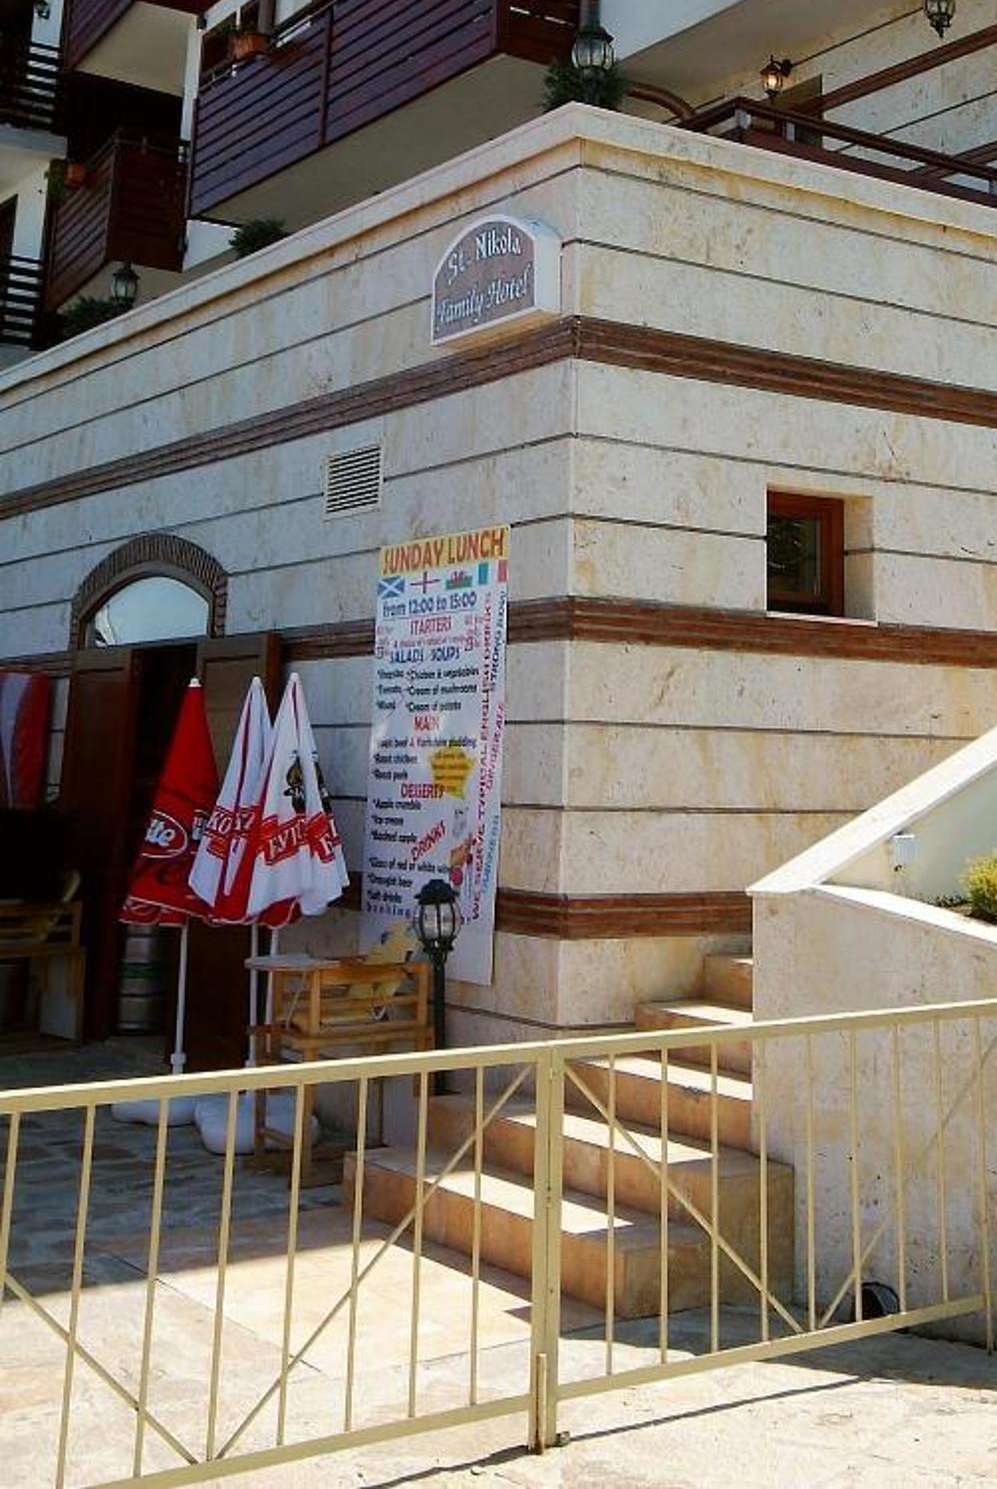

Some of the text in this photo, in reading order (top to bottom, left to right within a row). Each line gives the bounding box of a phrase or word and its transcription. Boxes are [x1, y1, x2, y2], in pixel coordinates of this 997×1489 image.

[475, 227, 522, 261] Nikola
[437, 261, 532, 324] Family Hotel
[383, 528, 506, 575] SUNDAY LUNCH
[382, 591, 478, 618] from 12:00 to 15:00
